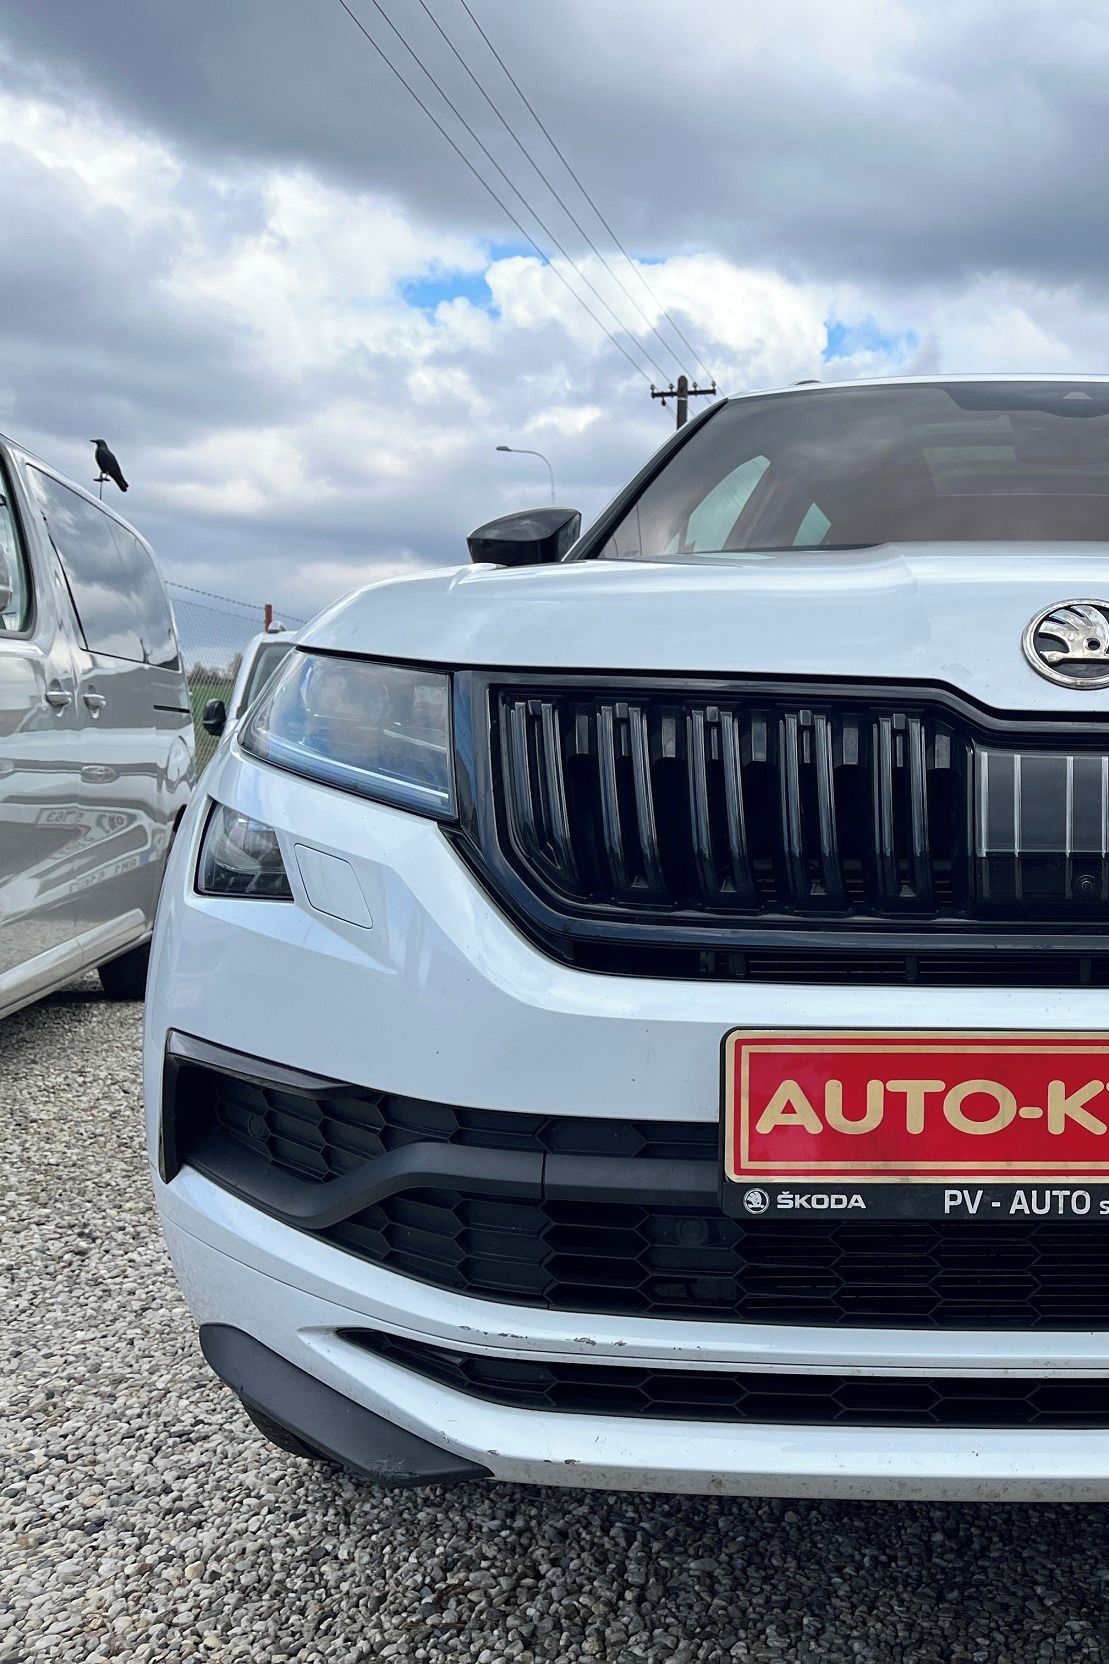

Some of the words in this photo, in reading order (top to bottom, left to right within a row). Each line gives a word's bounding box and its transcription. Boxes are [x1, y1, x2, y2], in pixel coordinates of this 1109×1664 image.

[776, 1190, 867, 1209] ŠKODA
[943, 1190, 984, 1214] PV
[1009, 1189, 1091, 1215] AUTO
